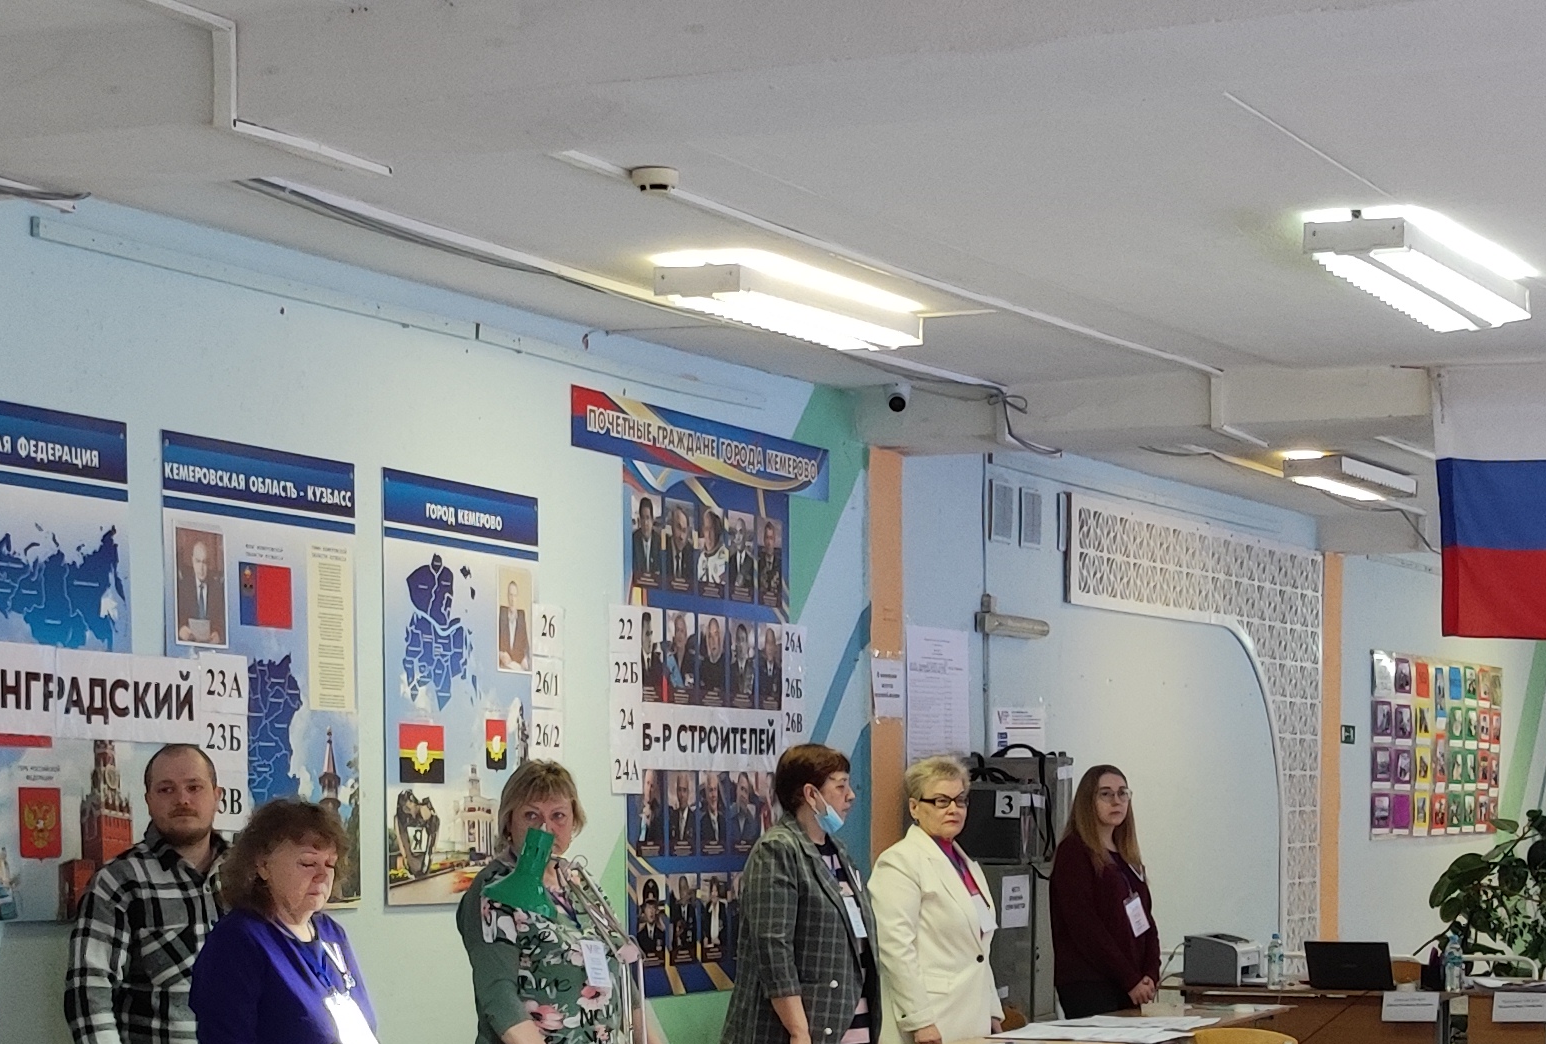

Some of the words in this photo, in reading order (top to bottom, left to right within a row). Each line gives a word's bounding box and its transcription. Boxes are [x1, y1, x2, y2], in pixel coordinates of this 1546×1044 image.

[16, 436, 100, 469] ФЕДЕРАЦИЯ
[587, 405, 652, 445] ПОЧЕТНЫЕ
[656, 424, 716, 458] ГРАЖДАНЕ
[719, 438, 764, 473] ГОРОДА
[766, 450, 818, 482] КЕМЕРОВО
[163, 461, 246, 491] КЕМЕРОВСКАЯ
[249, 476, 298, 500] ОБЛАСТЬ
[307, 484, 352, 508] КУЗБАСС
[425, 502, 456, 526] ГОРОД
[458, 508, 503, 531] КЕМЕРОВО
[541, 615, 556, 638] 26
[618, 618, 633, 640] 22
[535, 670, 559, 697] 26/1
[614, 661, 639, 684] 22Б
[785, 677, 803, 699] 26Б
[620, 708, 635, 730] 24
[206, 723, 242, 751] 23Б
[535, 723, 560, 748] 26/2
[642, 722, 672, 752] Б-Р
[676, 718, 776, 756] СТРОИТЕЛЕЙ
[1000, 794, 1014, 815] 3
